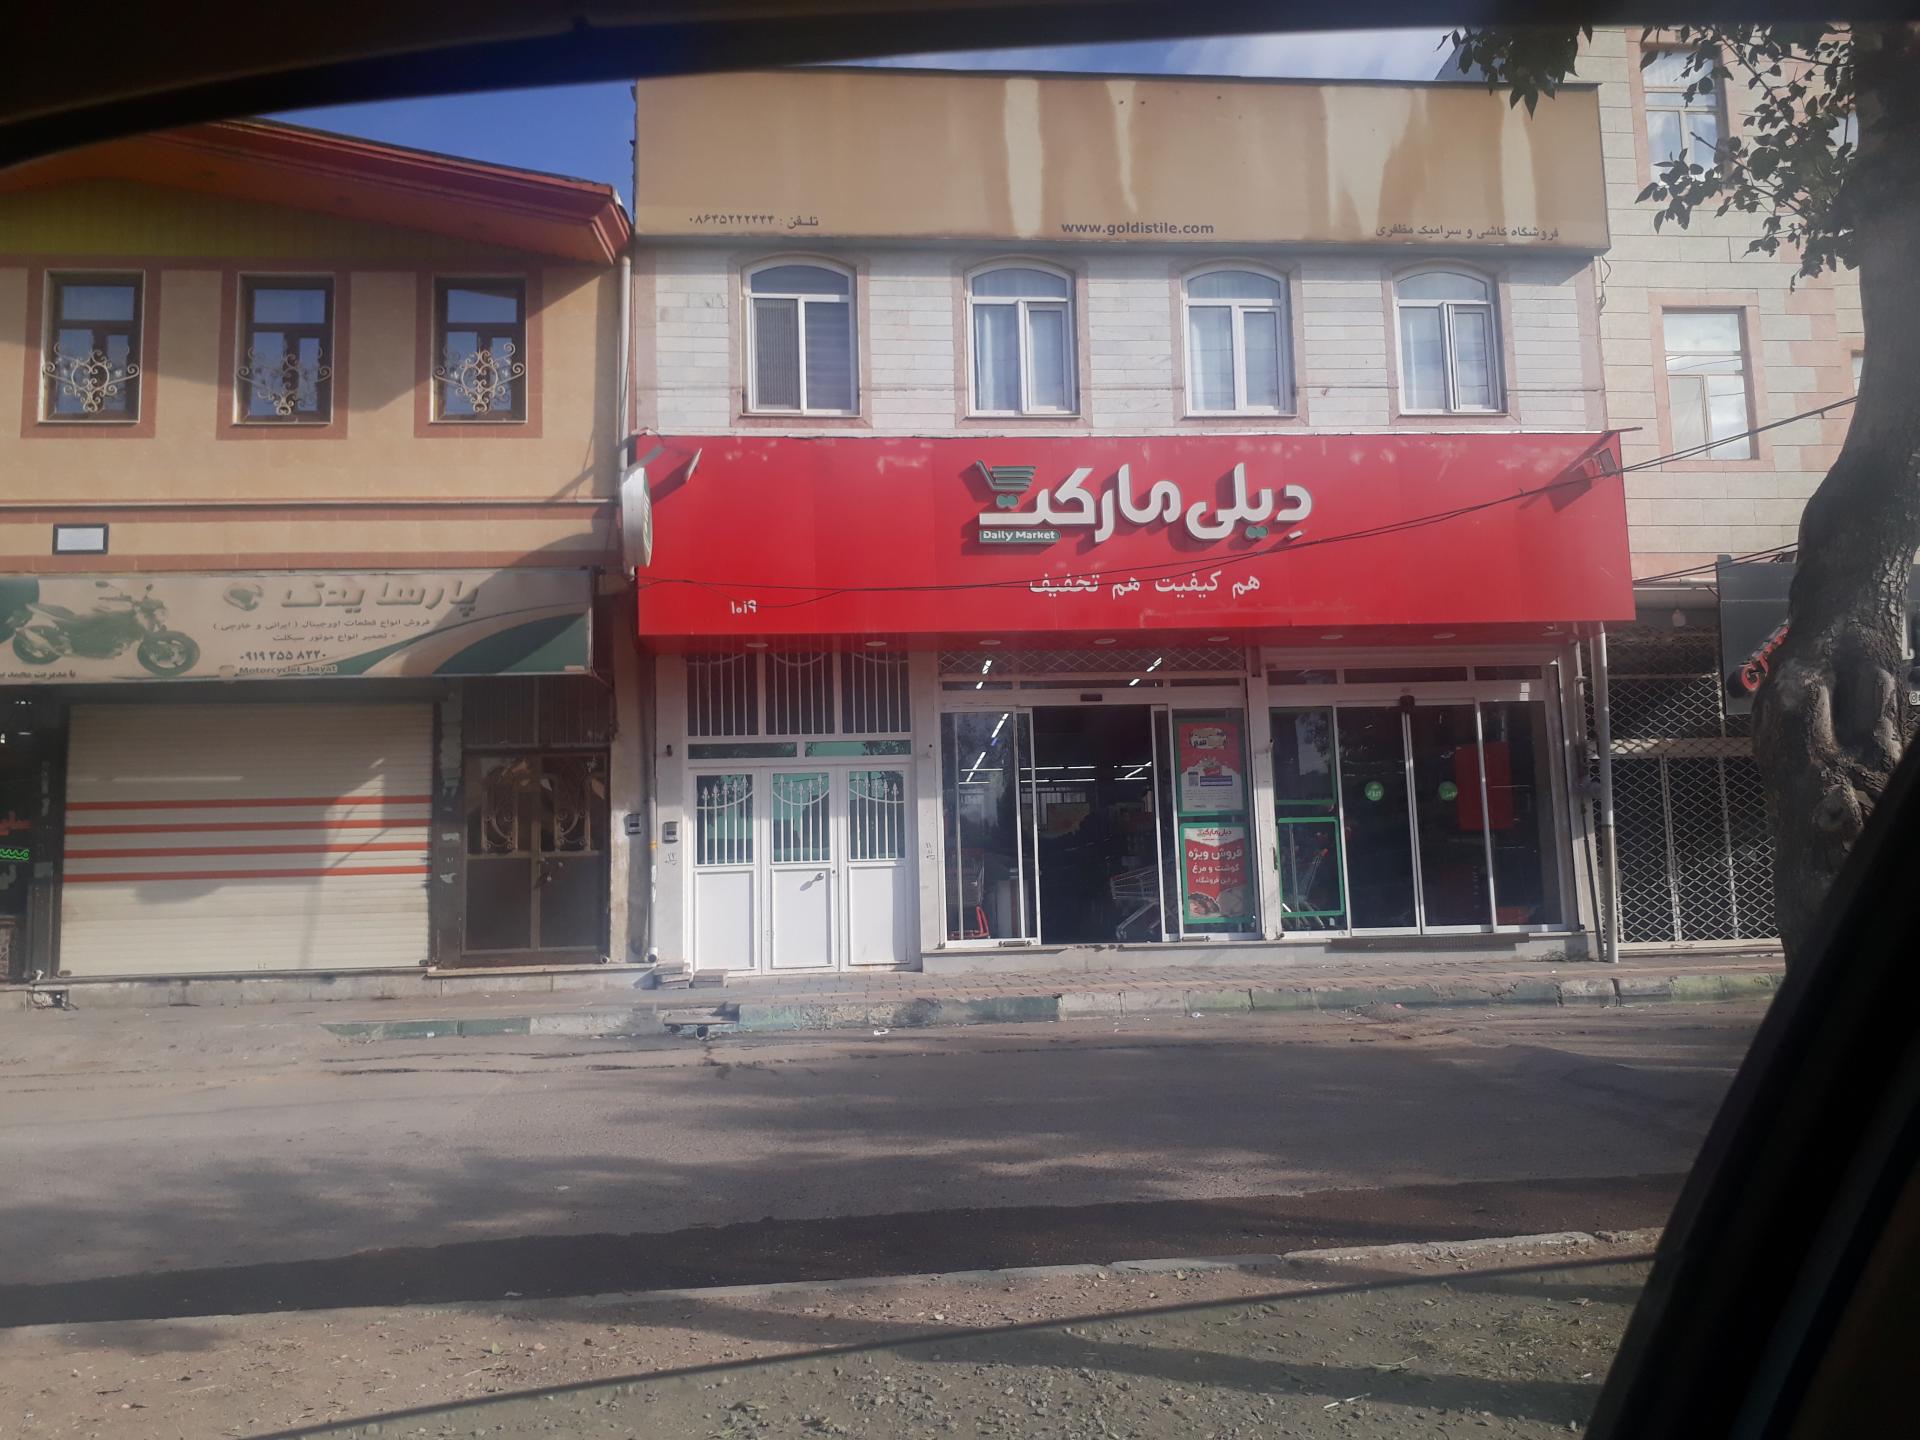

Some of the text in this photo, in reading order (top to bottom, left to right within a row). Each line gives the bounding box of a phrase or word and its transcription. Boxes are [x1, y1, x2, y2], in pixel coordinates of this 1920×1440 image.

[1061, 222, 1214, 235] www.goldistile.com
[1375, 223, 1559, 240] فروشگاه کاشی و سرامیک مظفری
[983, 530, 1055, 541] Daily Market
[1029, 570, 1260, 600] هم کیفیت هم تخفیف
[344, 618, 377, 627] قطعات
[380, 618, 401, 629] انواع
[403, 618, 430, 628] فروش
[338, 632, 359, 642] انواع
[1188, 848, 1242, 860] فروش ویژه
[1192, 863, 1207, 873] مرغ
[1215, 863, 1239, 873] گوشت
